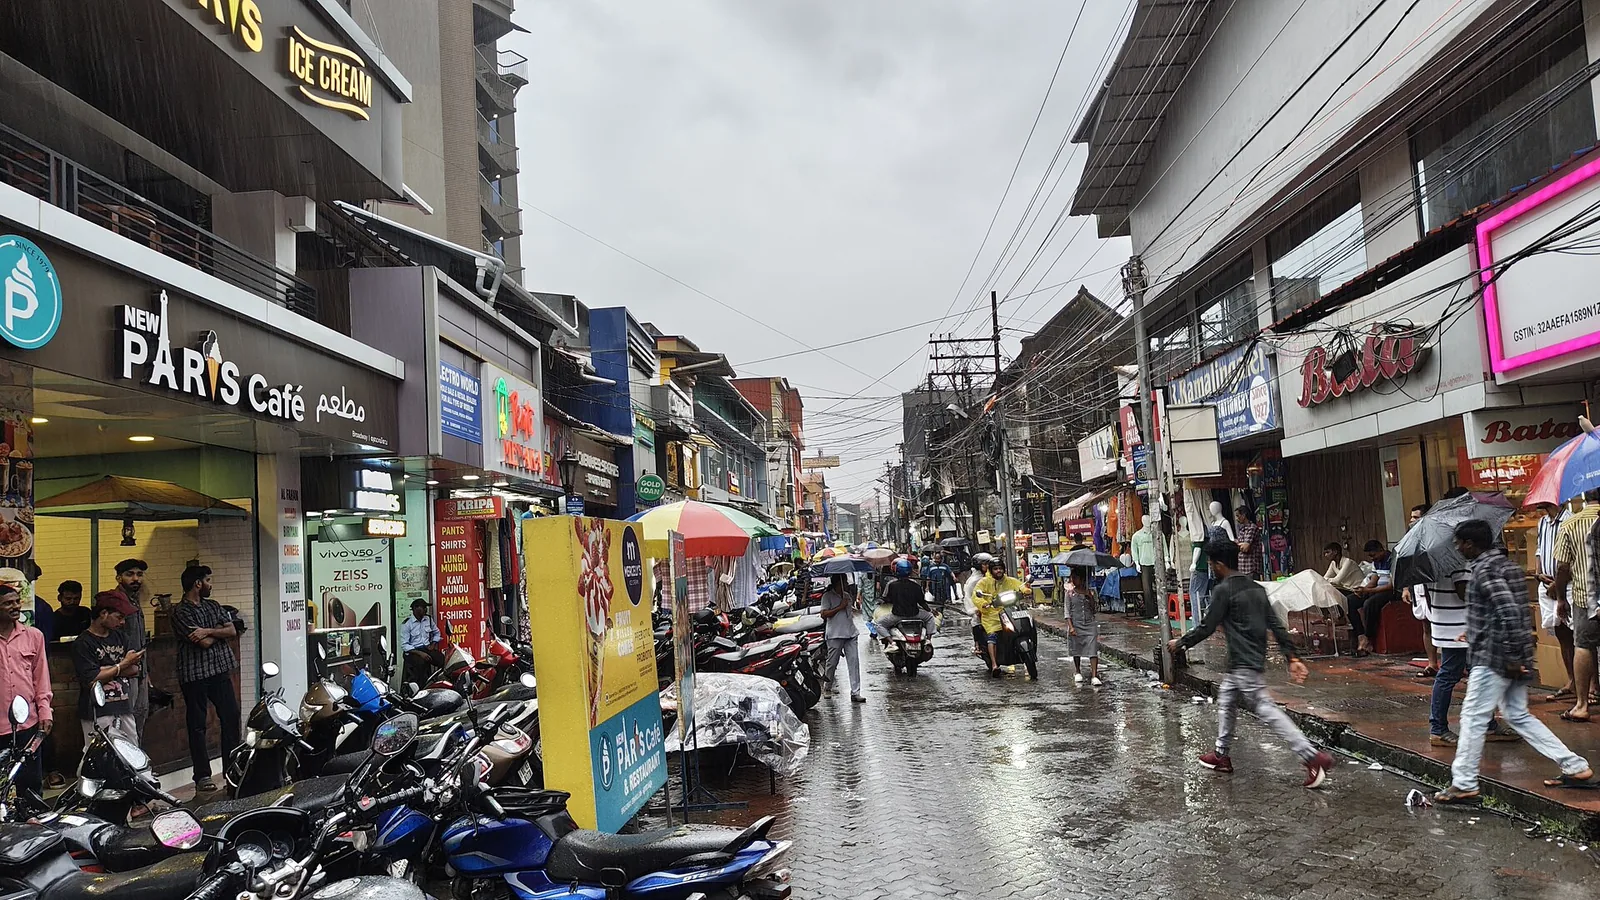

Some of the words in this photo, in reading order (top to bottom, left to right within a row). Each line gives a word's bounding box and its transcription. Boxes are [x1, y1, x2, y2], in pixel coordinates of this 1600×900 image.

[289, 36, 314, 85] ICE
[319, 55, 372, 107] CREAM
[15, 240, 36, 257] SINCE
[36, 255, 50, 273] 1979
[124, 304, 160, 335] NEW
[1513, 326, 1536, 342] GSTIN:
[460, 374, 479, 396] WORLD
[249, 372, 305, 422] Café
[316, 386, 366, 423] مطعم
[1253, 402, 1268, 418] 1927
[1481, 418, 1580, 443] Bata
[641, 480, 660, 488] GOLD
[640, 487, 660, 495] LOAN
[457, 498, 494, 510] KRIPA
[441, 525, 465, 535] PANTS
[284, 544, 299, 556] CHINESE
[441, 539, 467, 549] SHIRTS
[319, 550, 348, 558] vivo
[351, 549, 373, 557] V50
[443, 553, 465, 563] LUNGI
[441, 562, 468, 572] MUNDU
[333, 569, 369, 581] ZEISS
[447, 575, 463, 584] KAVI
[285, 581, 300, 593] BURGER
[319, 583, 353, 593] Portrait
[355, 583, 366, 591] So
[368, 582, 383, 591] Pro
[441, 584, 469, 594] MUNDU
[291, 600, 304, 612] COFFEE
[441, 595, 469, 606] PAJAMA
[439, 610, 473, 620] T-SHIRTS
[478, 562, 486, 658] KRIPA
[286, 618, 301, 631] SNACKS
[615, 732, 624, 747] NEW
[646, 720, 661, 751] Café
[623, 778, 629, 796] &
[629, 751, 660, 791] RESTAURANT
